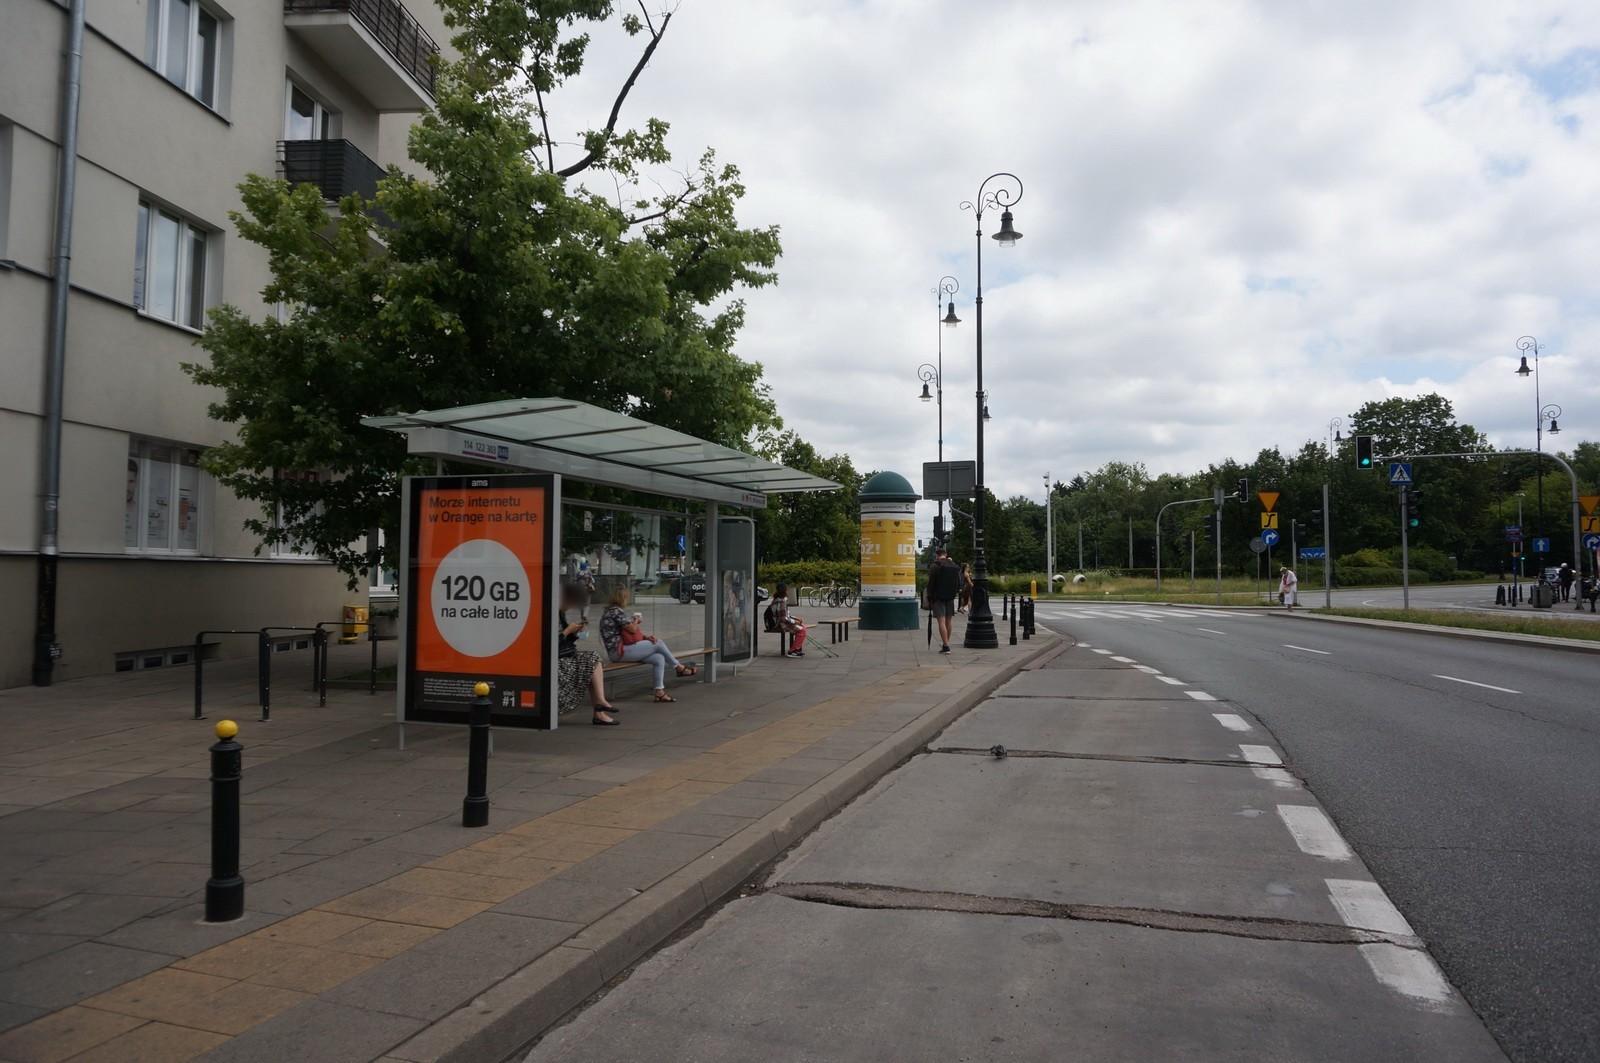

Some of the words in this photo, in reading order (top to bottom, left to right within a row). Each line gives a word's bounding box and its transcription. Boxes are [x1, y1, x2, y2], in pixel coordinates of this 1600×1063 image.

[428, 495, 465, 508] Morze
[468, 496, 521, 508] internetu
[428, 513, 438, 522] w
[441, 511, 484, 525] Orange
[487, 513, 502, 522] na
[505, 511, 537, 525] kartę
[441, 575, 485, 601] 120
[489, 581, 520, 602] GB
[441, 607, 457, 618] na
[460, 605, 490, 619] całe
[493, 605, 518, 620] lato
[502, 695, 515, 708] #1
